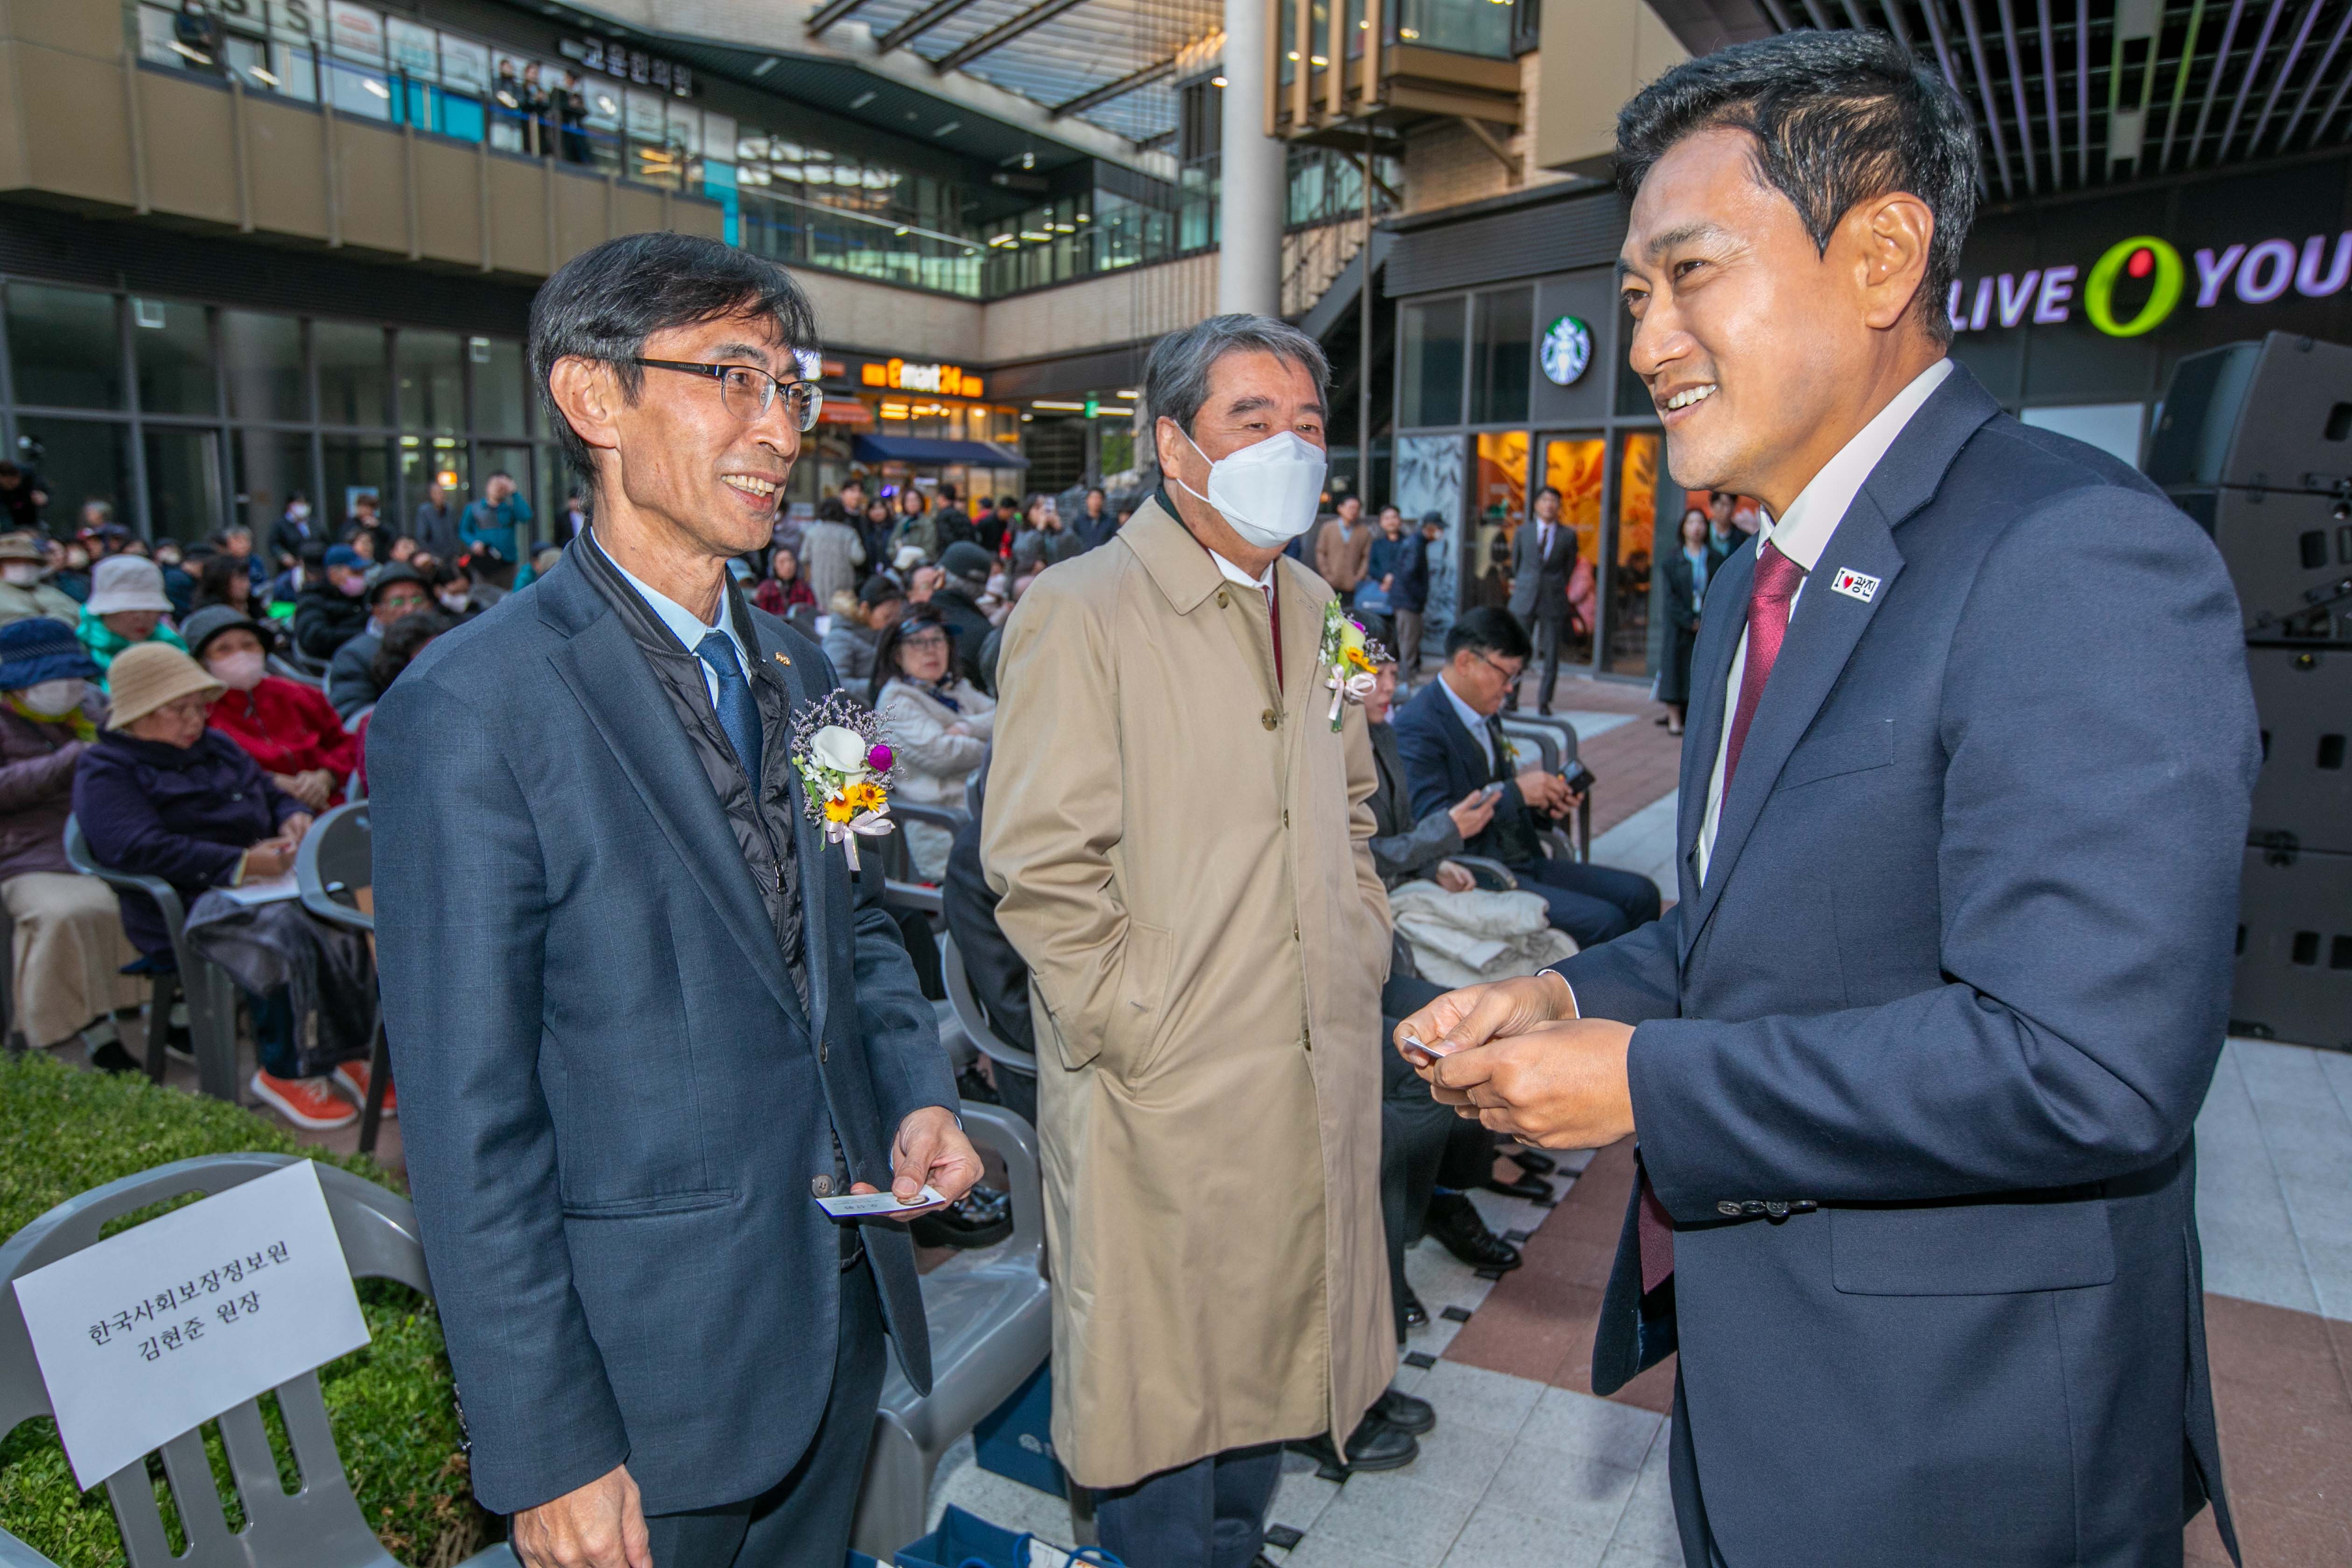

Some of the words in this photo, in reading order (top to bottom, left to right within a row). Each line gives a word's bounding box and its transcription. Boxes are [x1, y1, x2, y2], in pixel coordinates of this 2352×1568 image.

[2194, 230, 2352, 308] YOU
[1834, 571, 1845, 587] I
[1852, 576, 1876, 597] 광진
[88, 1240, 291, 1346] 한국사회보장정보원
[138, 1316, 205, 1361] 김현준
[216, 1290, 261, 1324] 원장
